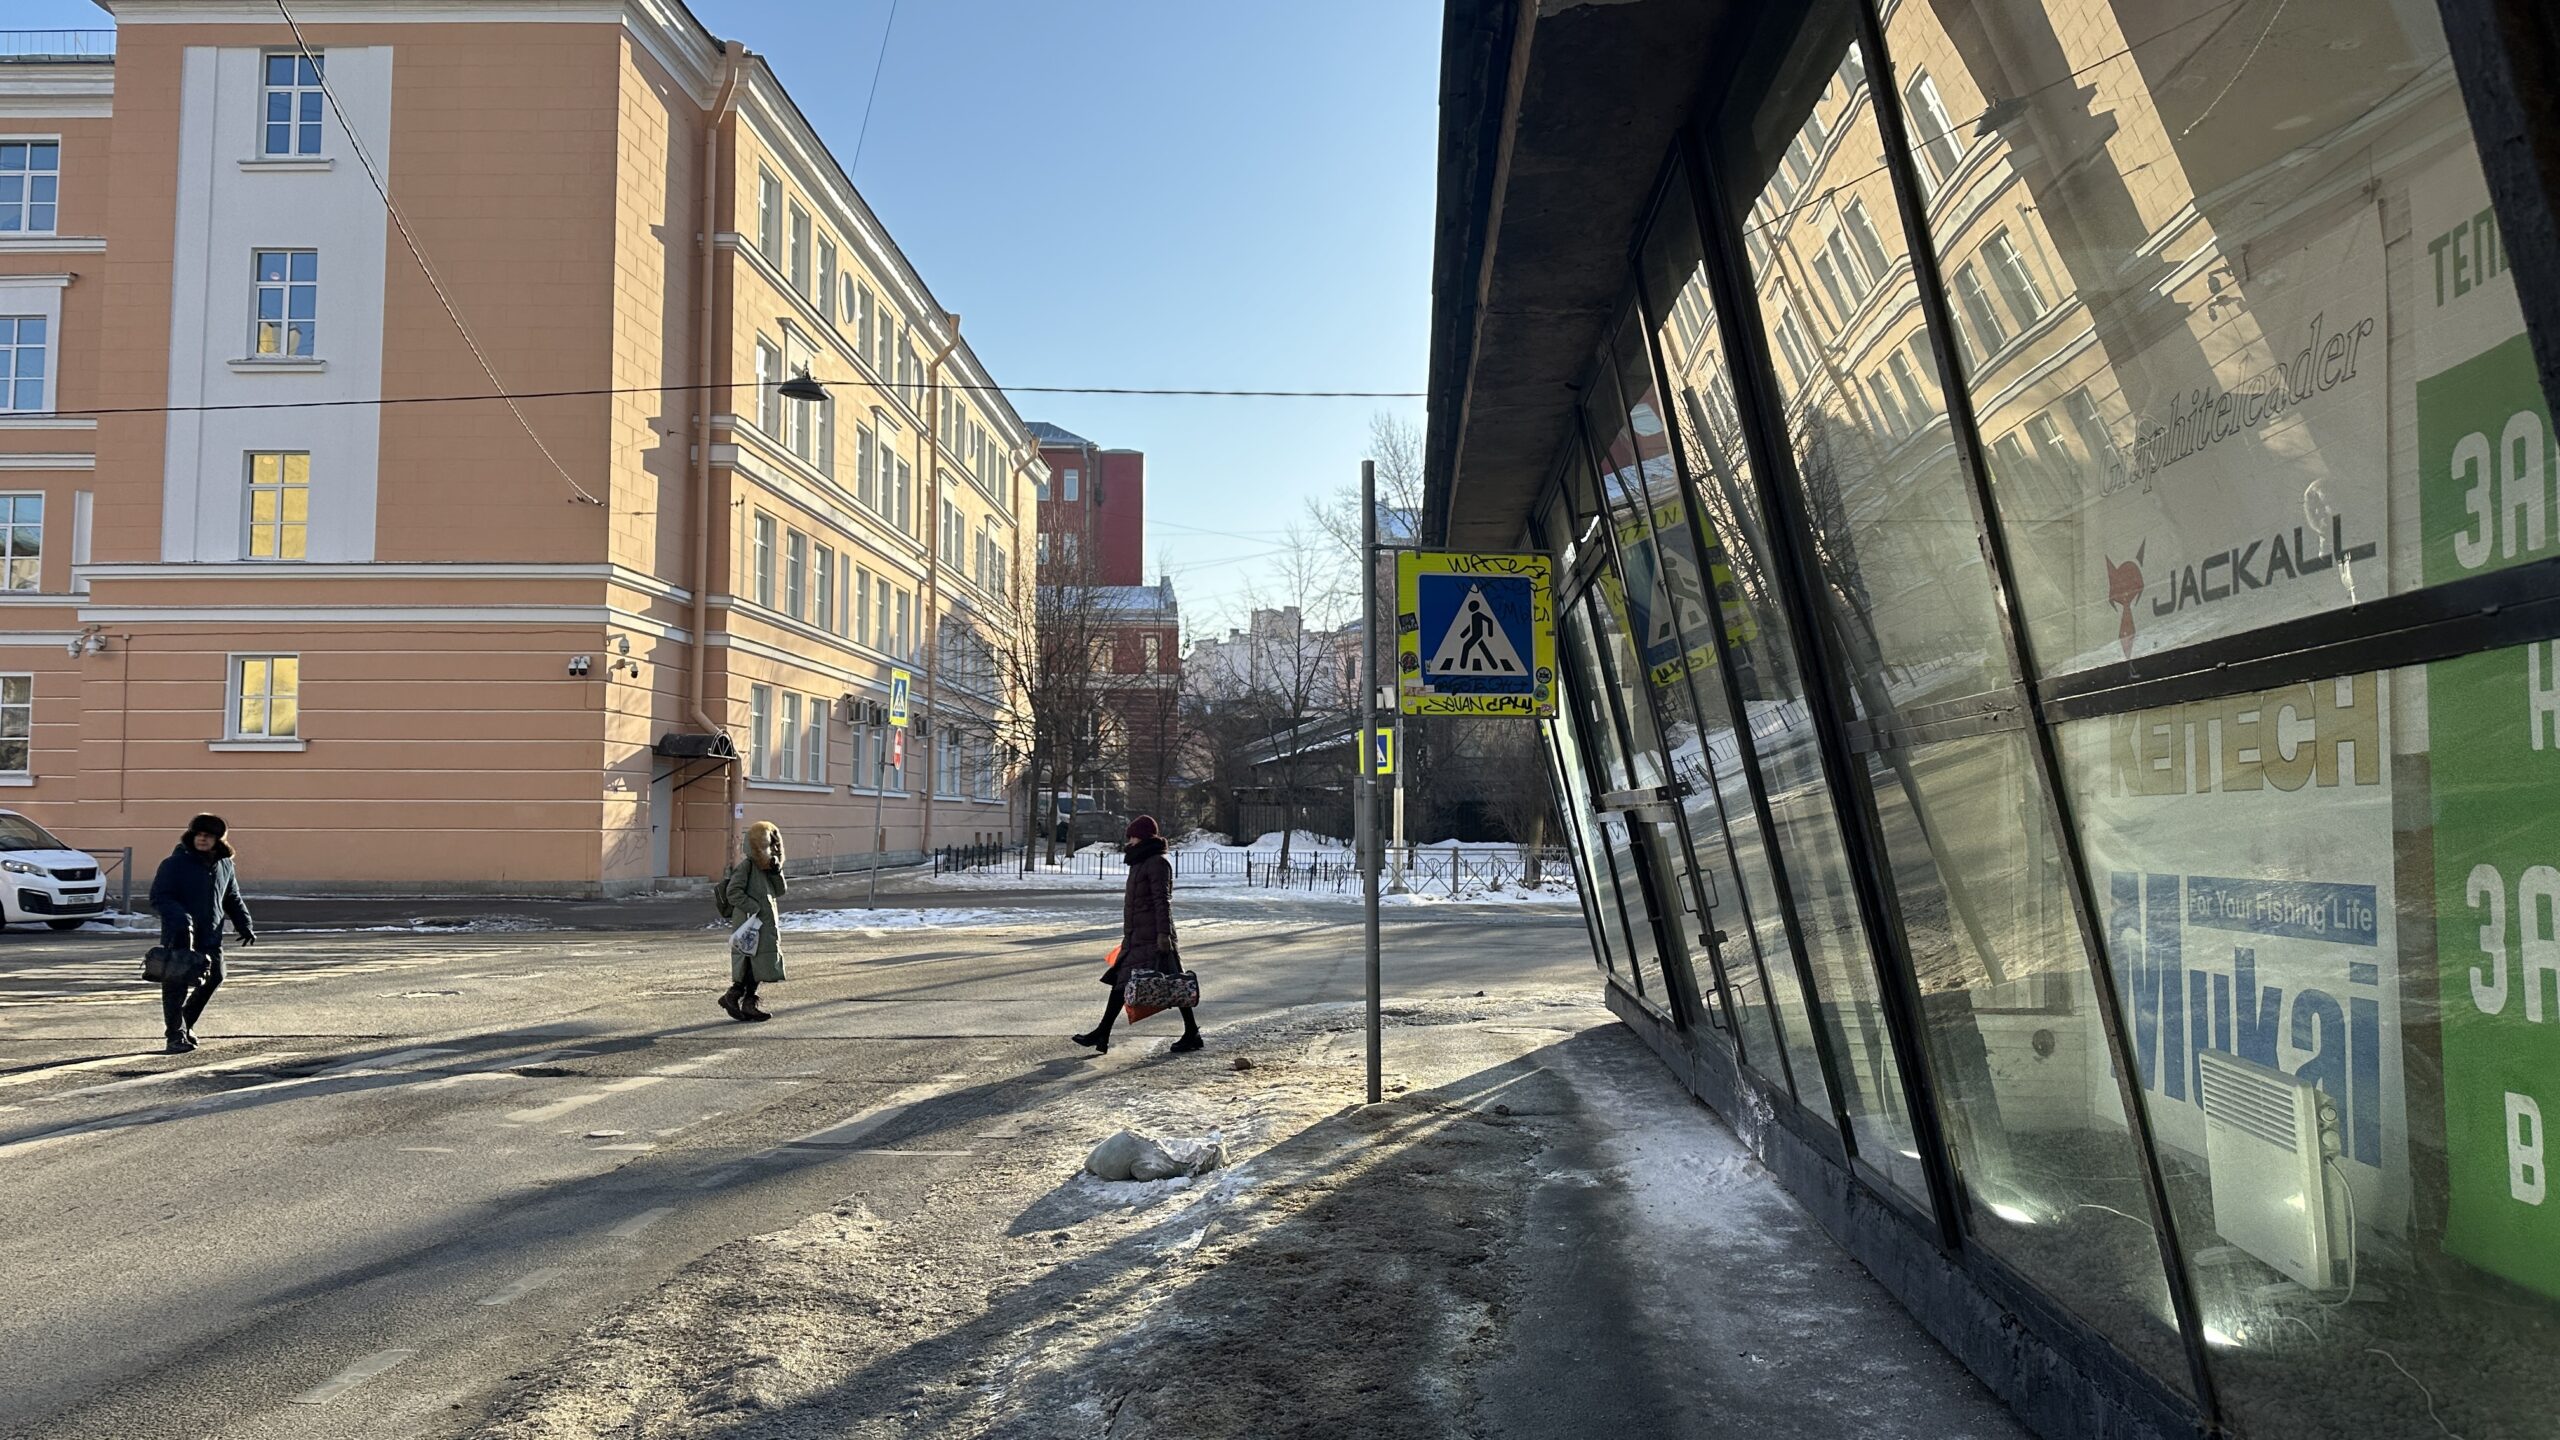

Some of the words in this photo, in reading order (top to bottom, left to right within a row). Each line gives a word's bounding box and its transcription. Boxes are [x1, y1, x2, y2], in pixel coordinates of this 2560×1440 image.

[2428, 204, 2510, 308] ТЕП
[2100, 311, 2374, 498] Graphiteleader
[2451, 409, 2560, 570] ЗА
[2152, 513, 2377, 618] JACKALL
[2109, 674, 2380, 798] KEITECH
[2189, 888, 2213, 916] For
[2216, 890, 2250, 918] Your
[2256, 893, 2326, 934] Fishing
[2333, 898, 2373, 932] Life
